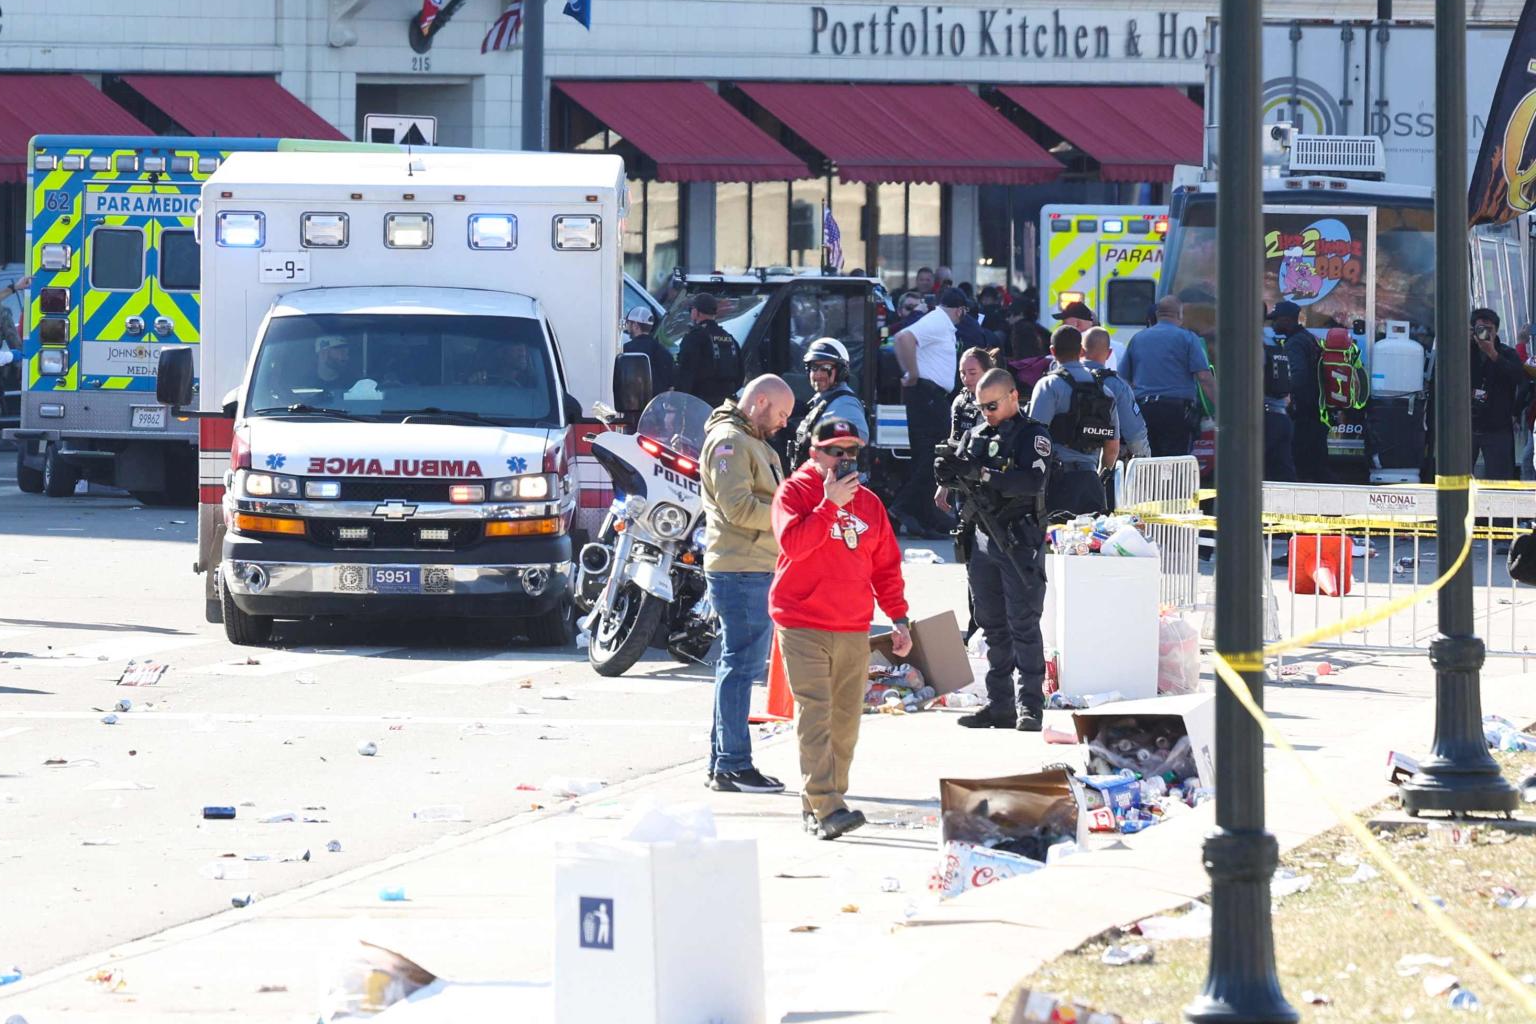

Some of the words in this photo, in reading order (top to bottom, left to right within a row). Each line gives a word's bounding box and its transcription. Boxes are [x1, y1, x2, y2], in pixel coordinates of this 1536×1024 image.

[810, 6, 965, 55] Portfolio
[978, 8, 1110, 57] Kitchen
[1124, 18, 1143, 57] &
[1157, 12, 1198, 58] Ho
[412, 56, 431, 71] 215
[46, 192, 70, 211] 62
[97, 196, 199, 213] PARAMEDIC
[127, 366, 158, 376] MED-A
[653, 463, 702, 496] POLIC
[1369, 494, 1417, 505] NATIONAL
[375, 570, 412, 584] 5951
